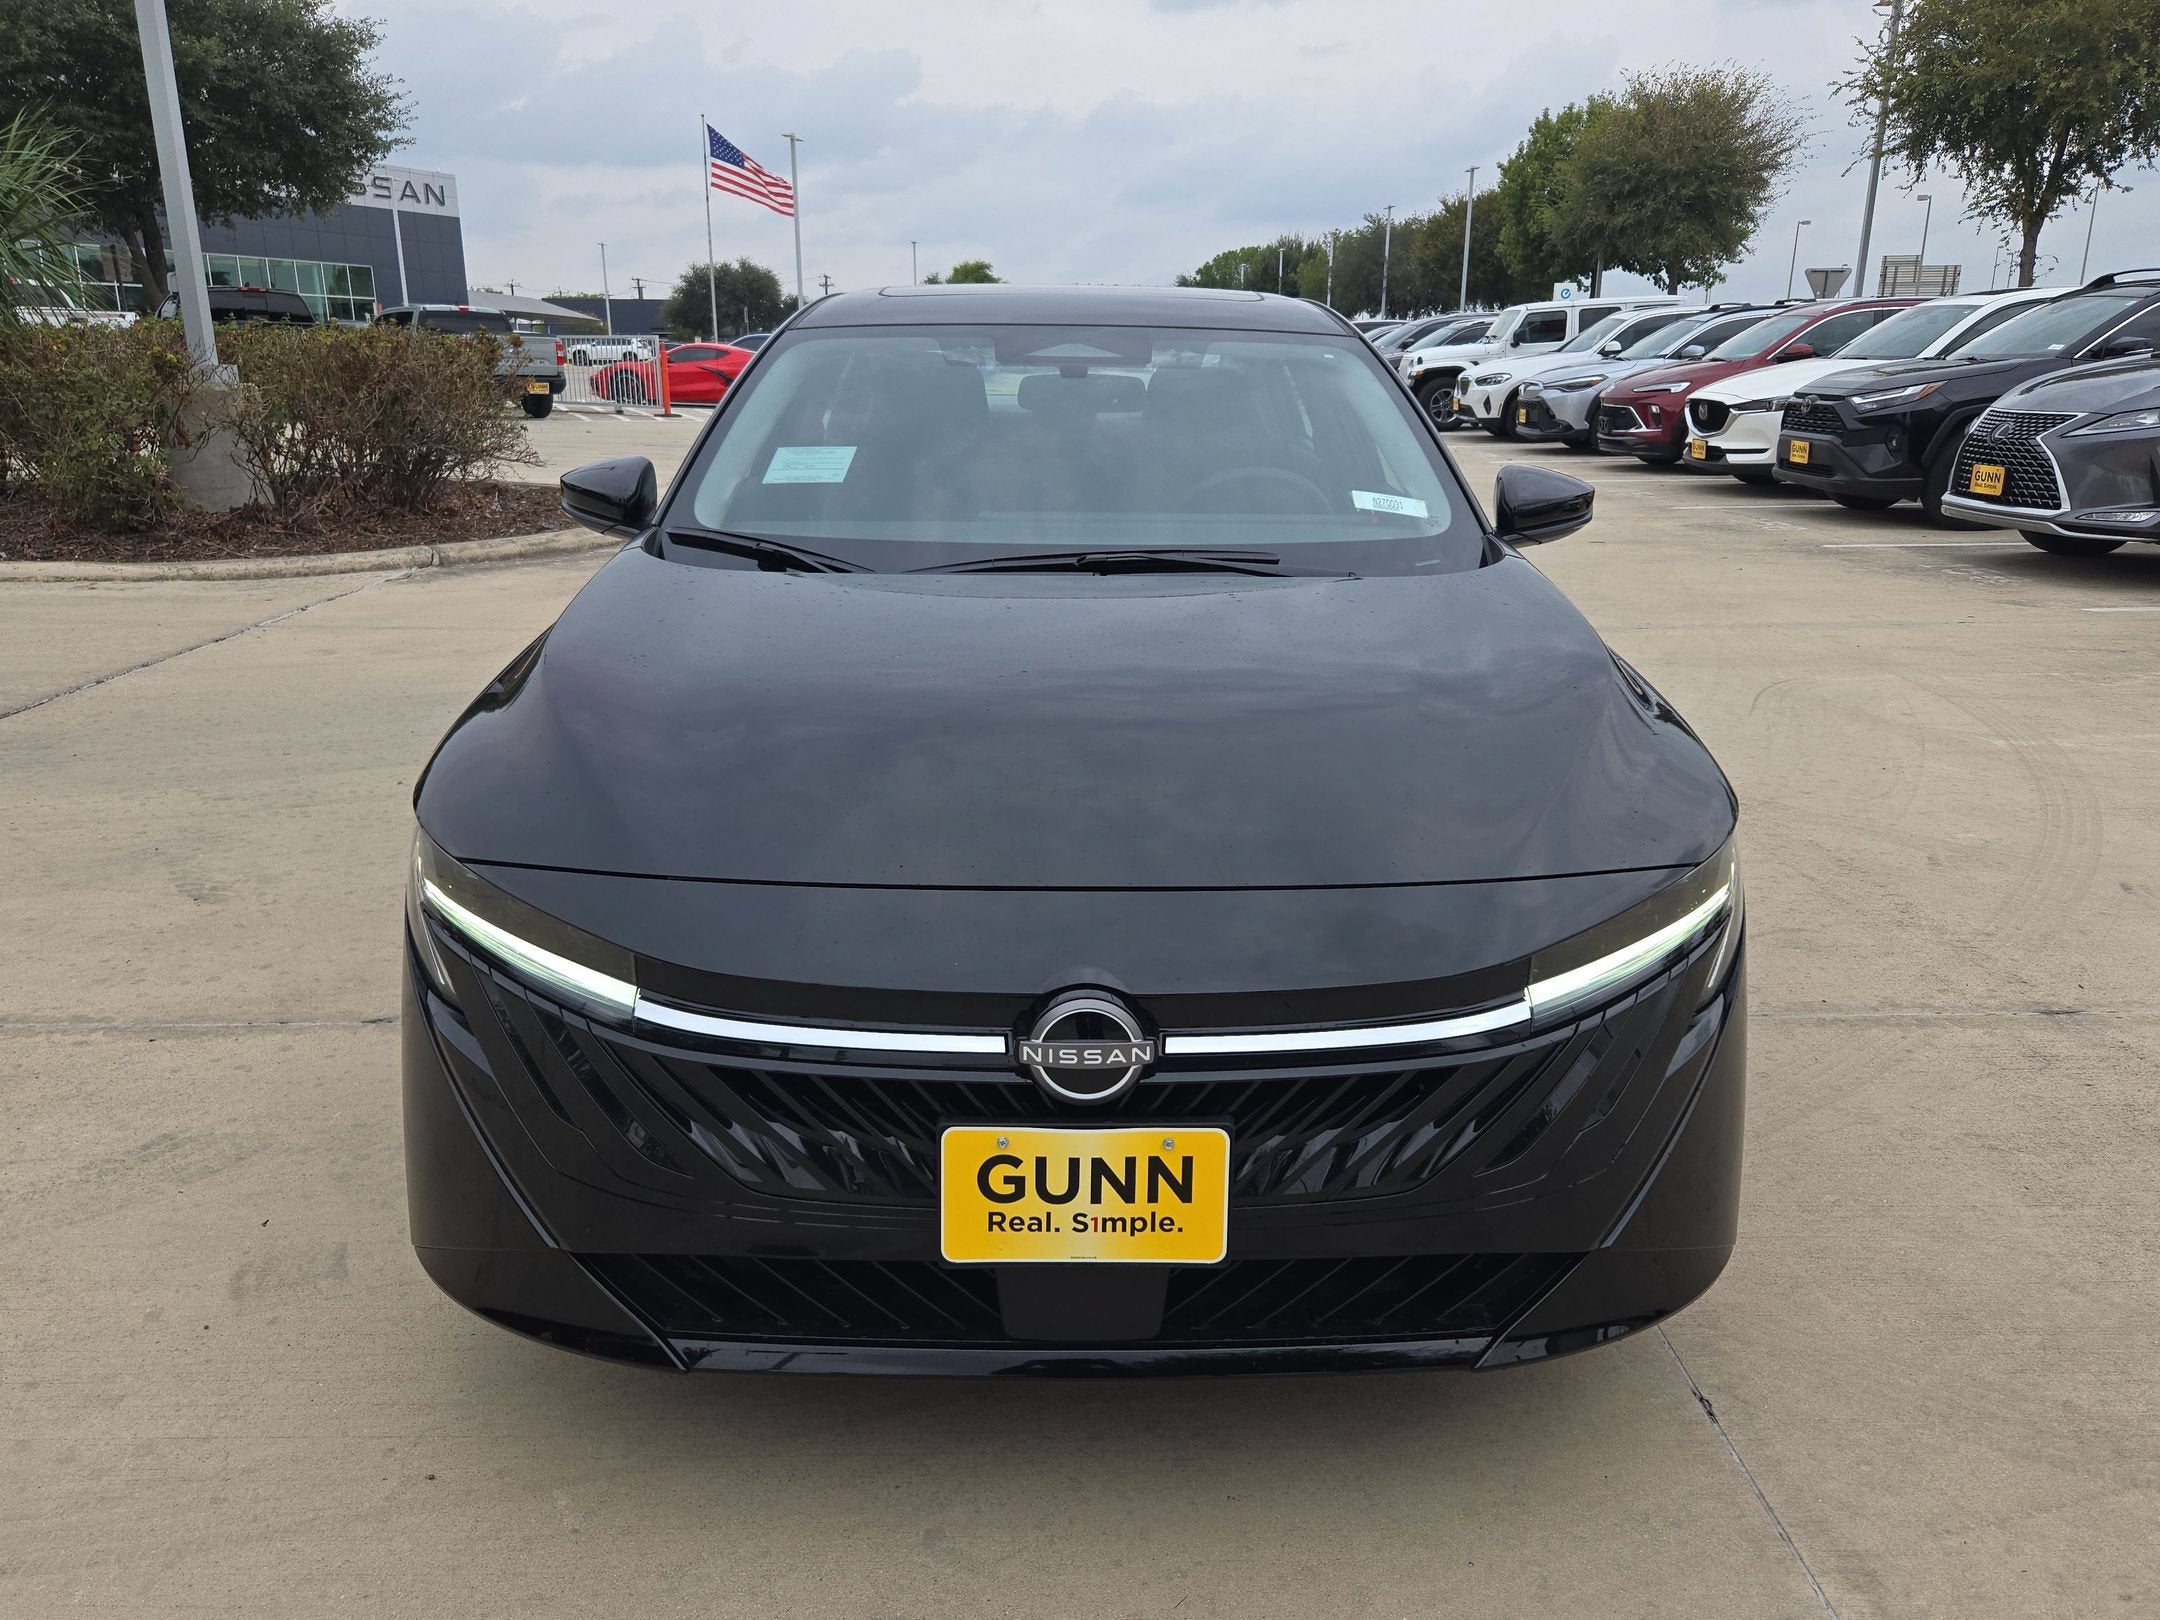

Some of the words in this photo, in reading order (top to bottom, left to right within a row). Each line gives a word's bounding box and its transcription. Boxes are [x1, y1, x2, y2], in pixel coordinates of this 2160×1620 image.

[1974, 470, 2001, 483] GUNN
[1023, 1046, 1150, 1064] NISSAN
[976, 1154, 1194, 1205] GUNN
[987, 1211, 1060, 1233] Real.
